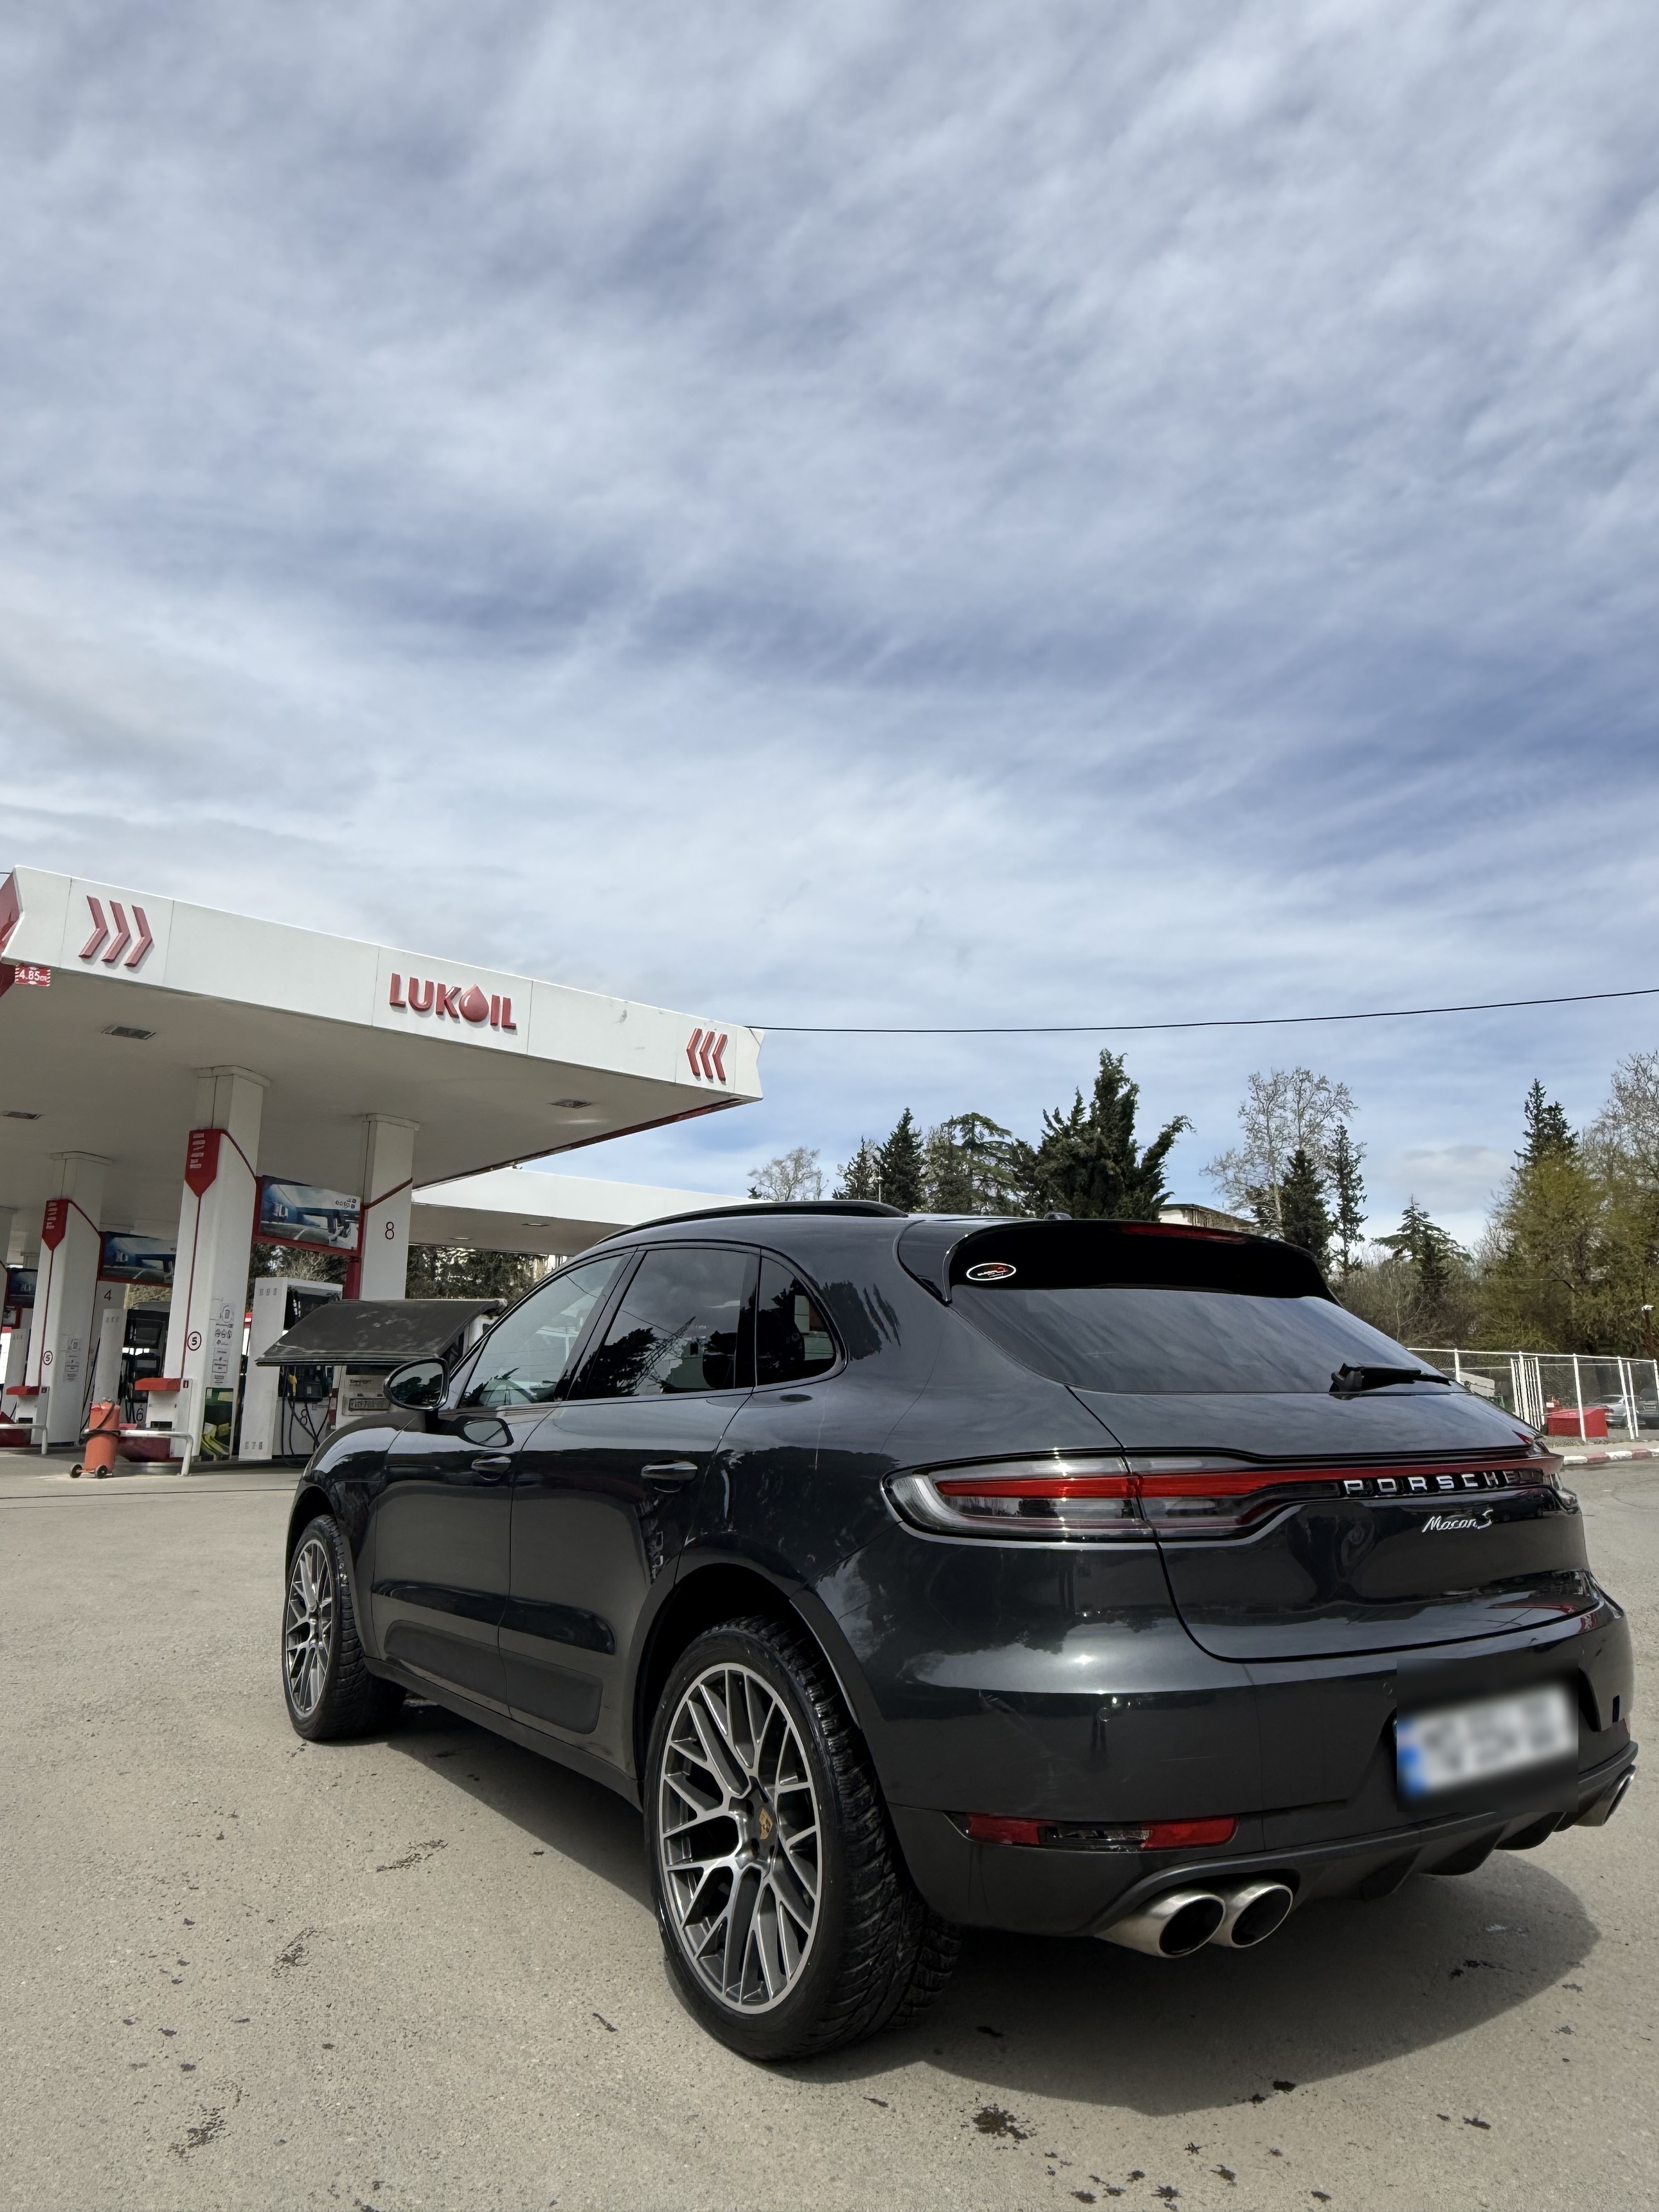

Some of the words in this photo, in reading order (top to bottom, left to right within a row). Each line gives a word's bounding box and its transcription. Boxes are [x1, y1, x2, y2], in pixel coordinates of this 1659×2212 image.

[385, 1222, 394, 1240] 8
[104, 1289, 112, 1301] 4
[191, 1336, 198, 1346] 5
[1344, 1470, 1517, 1494] PORSCHE
[1421, 1515, 1477, 1533] Macan
[1477, 1509, 1493, 1530] S
